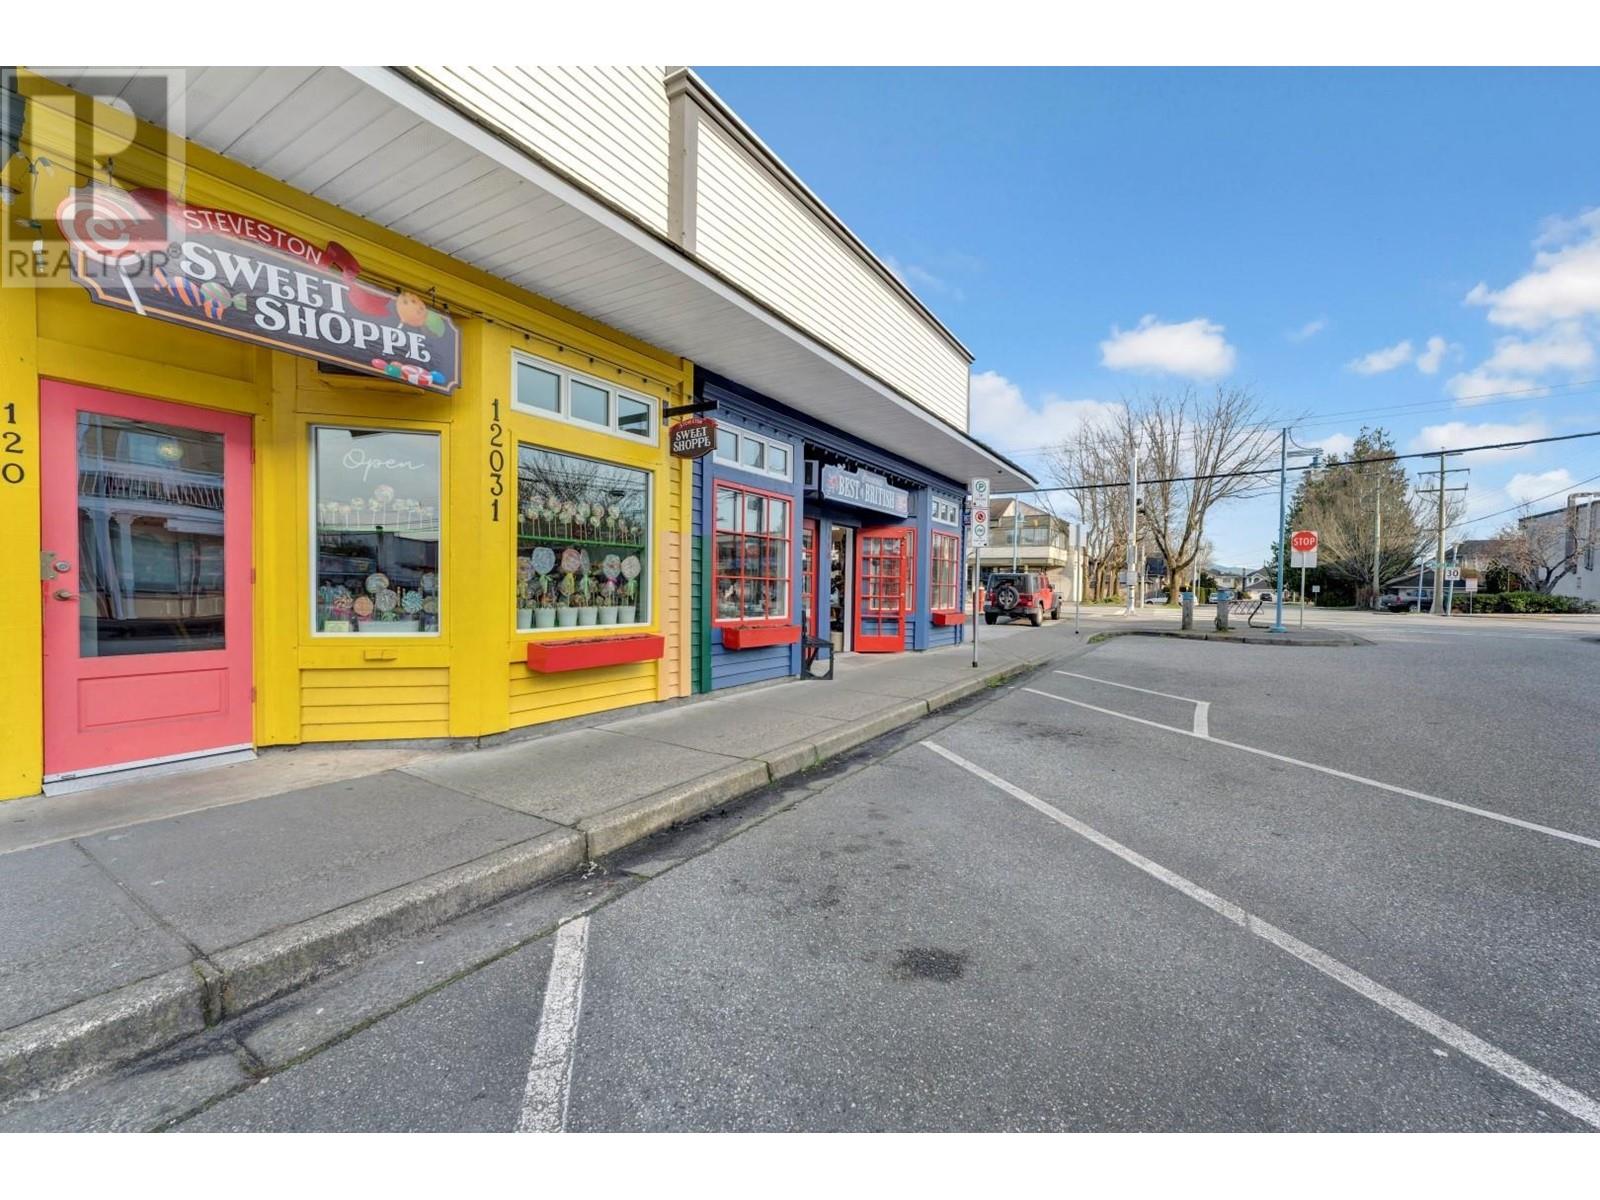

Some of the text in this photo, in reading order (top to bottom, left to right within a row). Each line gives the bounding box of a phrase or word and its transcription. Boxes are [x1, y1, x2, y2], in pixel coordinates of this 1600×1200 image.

[183, 209, 323, 266] STEVESTON
[179, 240, 350, 315] SWEET
[254, 296, 432, 364] SHOPPE
[2, 402, 25, 484] 120
[673, 436, 711, 452] SHOPPE
[675, 426, 708, 441] SWEET
[342, 448, 425, 482] Open
[490, 399, 504, 522] 12031
[838, 475, 860, 500] BEST
[864, 483, 895, 509] BRITISH
[1293, 537, 1316, 546] STOP
[1447, 569, 1459, 577] 30
